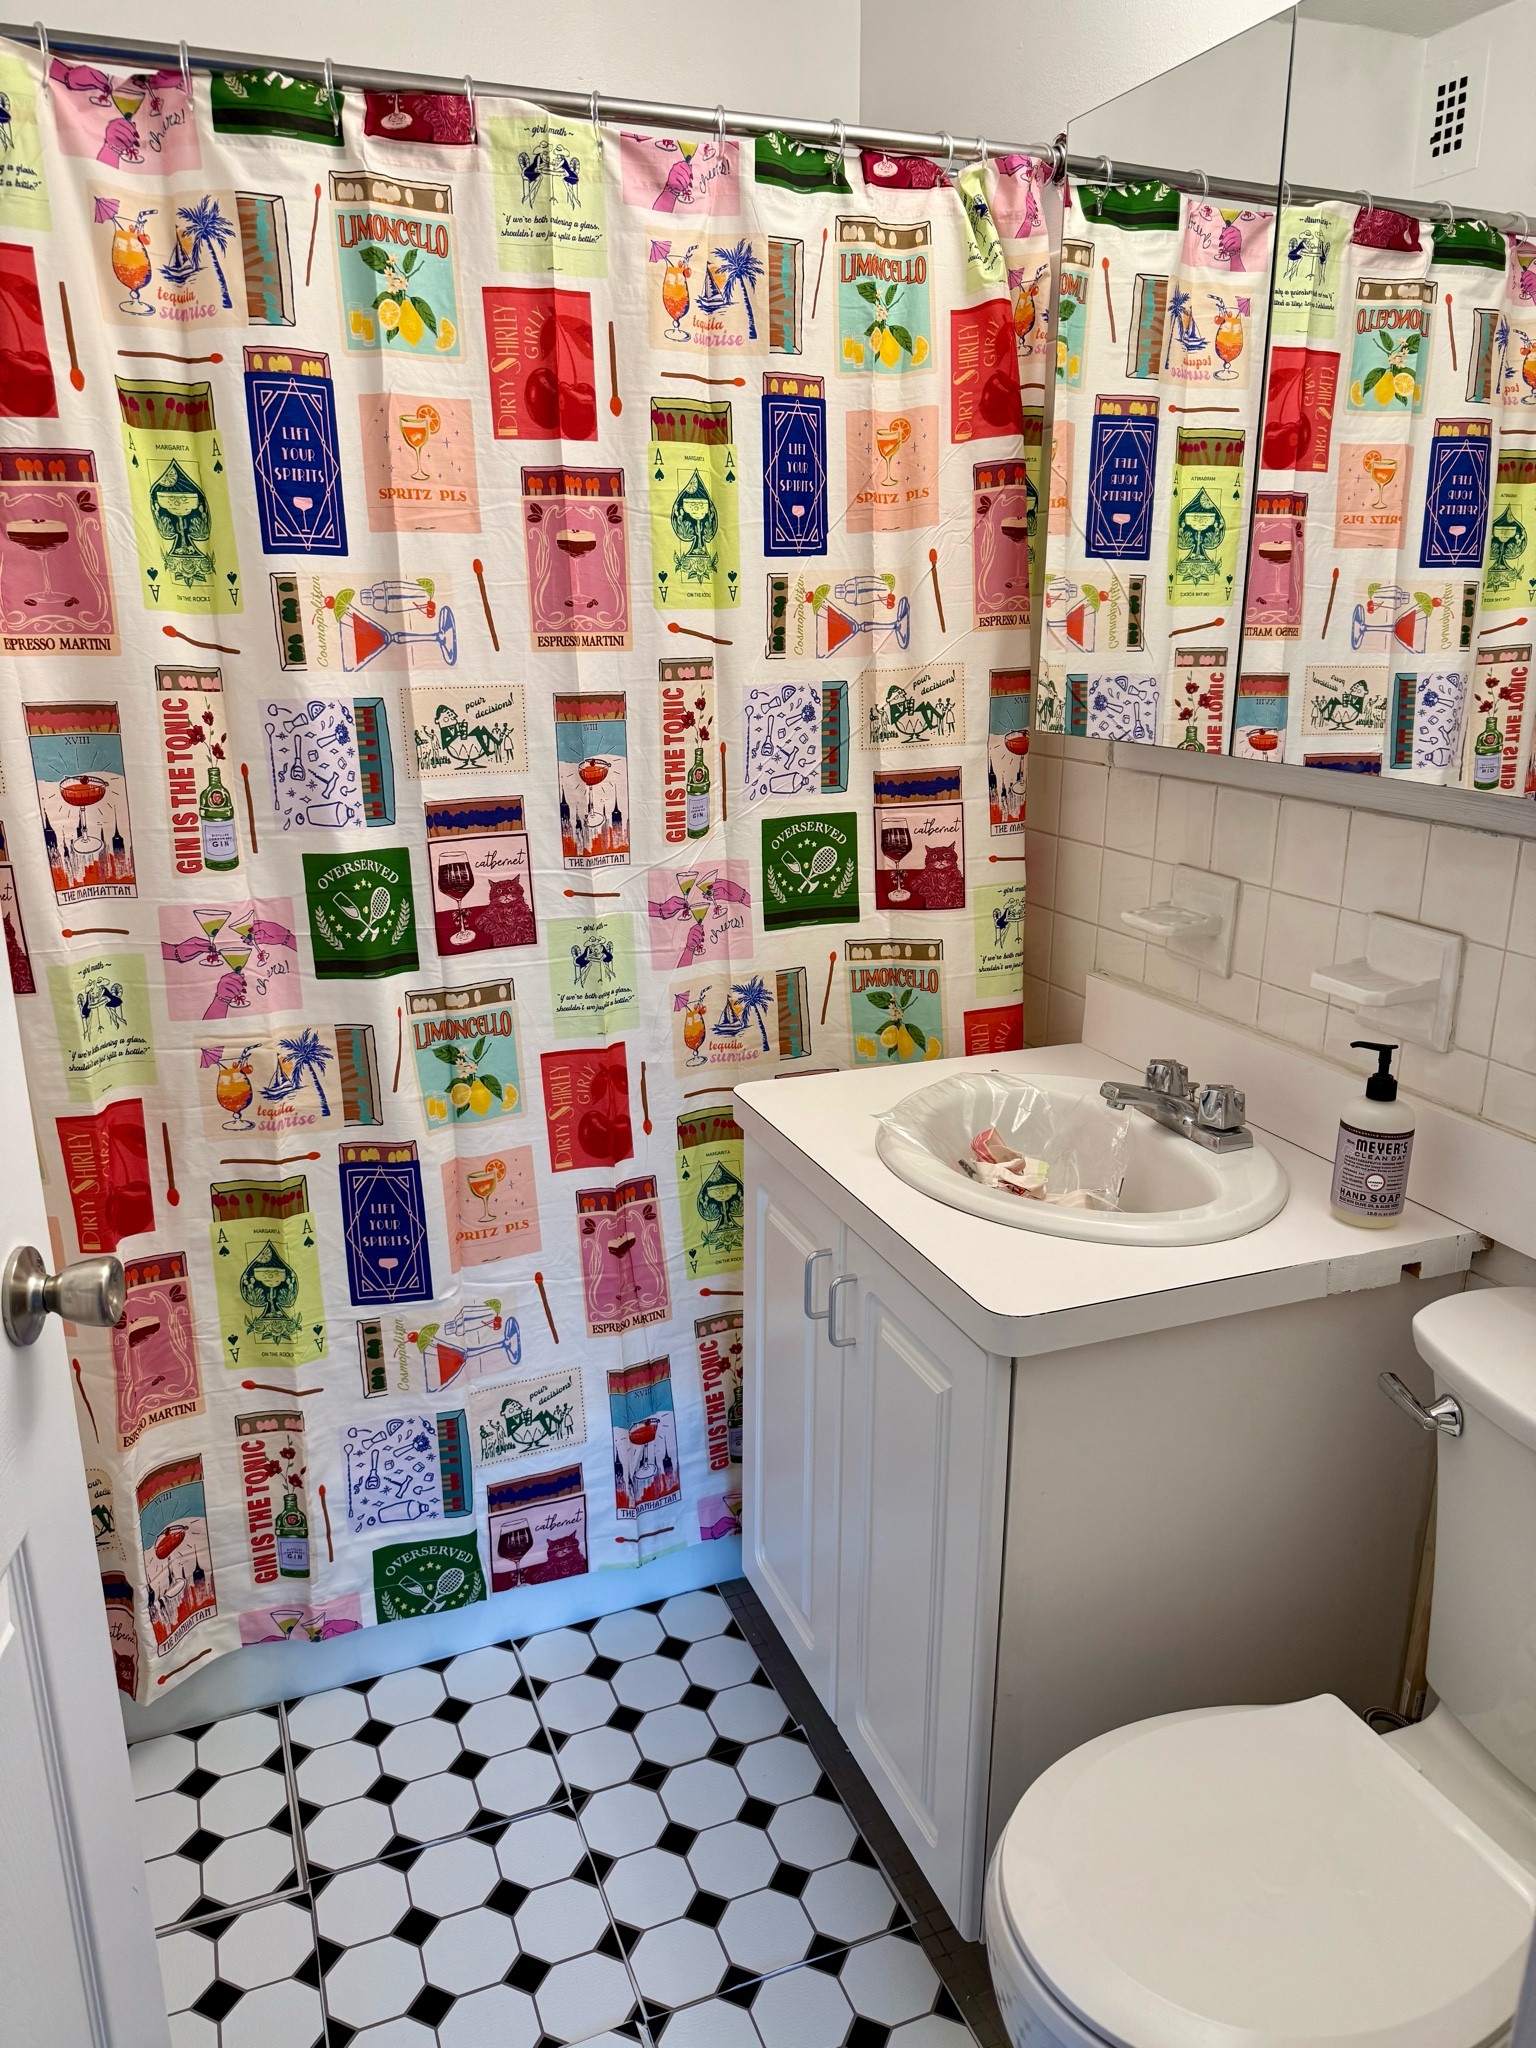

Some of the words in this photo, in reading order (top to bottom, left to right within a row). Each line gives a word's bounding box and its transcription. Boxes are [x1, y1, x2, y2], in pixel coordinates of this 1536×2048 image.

[533, 213, 550, 225] both
[338, 213, 449, 259] LIMONCELLO
[840, 251, 927, 285] LIMONCELLO
[157, 286, 196, 305] tequila
[159, 301, 218, 322] sunrise
[524, 306, 547, 360] GIRLY
[692, 315, 725, 332] tequila
[491, 303, 520, 375] SHIRLEY
[693, 330, 744, 348] sunrise
[984, 320, 1001, 368] GIRLY
[953, 323, 980, 385] SHIRLEY
[498, 378, 518, 437] DIRTY
[954, 390, 974, 443] DIRTY
[127, 432, 137, 452] A
[281, 426, 309, 442] LIFT
[155, 444, 190, 452] MARGARITA
[211, 438, 222, 457] A
[281, 447, 316, 463] YOUR
[654, 448, 665, 466] A
[788, 443, 808, 456] LIFT
[725, 451, 736, 469] A
[787, 461, 809, 474] YOUR
[273, 466, 325, 484] SPIRITS
[378, 487, 433, 502] SPRITZ
[440, 489, 467, 502] PLS
[779, 479, 814, 493] SPIRITS
[856, 491, 899, 506] SPRITZ
[905, 487, 929, 502] PLS
[313, 575, 328, 668] Cosmopolitan
[793, 573, 804, 656] Cosmopolitan
[978, 615, 1018, 628] ESPRESSO
[60, 637, 111, 651] MARTINI
[581, 635, 624, 647] MARTINI
[912, 674, 931, 688] pour
[920, 669, 956, 696] decisions!
[465, 696, 486, 714] pour
[475, 692, 514, 720] decisions!
[663, 687, 686, 745] TONIC
[162, 698, 194, 764] TONIC
[64, 736, 90, 746] XVIII
[664, 749, 686, 784] THE
[169, 767, 197, 808] THE
[665, 787, 685, 805] IS
[172, 811, 199, 833] IS
[665, 810, 686, 843] GIN
[913, 817, 962, 836] catbernet
[994, 824, 1008, 834] THE
[771, 821, 847, 851] OVERSERVED
[174, 841, 203, 874] GIN
[474, 848, 527, 869] catbernet
[569, 858, 585, 867] THE
[317, 858, 400, 890] OVERSERVED
[61, 889, 77, 902] THE
[77, 885, 131, 901] MANHATTAN
[851, 967, 938, 993] LIMONCELLO
[413, 1010, 512, 1050] LIMONCELLO
[709, 1041, 743, 1053] tequila
[710, 1048, 759, 1064] sunrise
[549, 1065, 575, 1121] SHIRLEY
[576, 1062, 596, 1105] GIRLY
[257, 1102, 295, 1121] tequila
[258, 1113, 317, 1133] sunrise
[555, 1126, 574, 1170] DIRTY
[706, 1149, 731, 1157] MARGARITA
[1354, 1151, 1388, 1161] CLEAN
[1356, 1138, 1408, 1155] MEYER'S
[67, 1131, 100, 1196] SHIRLEY
[680, 1155, 690, 1169] A
[1340, 1187, 1367, 1201] HAND
[1370, 1193, 1401, 1203] SOAP
[370, 1203, 395, 1215] LIFT
[81, 1199, 101, 1252] DIRTY
[301, 1219, 313, 1235] A
[369, 1219, 400, 1231] YOUR
[506, 1219, 529, 1234] PLS
[217, 1228, 229, 1244] A
[362, 1235, 410, 1248] SPIRITS
[396, 1316, 410, 1391] Cosmopolitan
[699, 1340, 725, 1390] TONIC
[529, 1385, 548, 1399] pour
[538, 1376, 572, 1406] decisions!
[148, 1401, 197, 1426] MARTINI
[706, 1390, 726, 1424] THE
[708, 1427, 728, 1444] IS
[241, 1439, 270, 1497] TONIC
[710, 1446, 729, 1471] GIN
[248, 1498, 273, 1533] THE
[535, 1509, 584, 1532] catbernet
[621, 1509, 635, 1518] THE
[250, 1535, 275, 1553] IS
[254, 1556, 279, 1584] GIN
[385, 1545, 474, 1576] OVERSERVED
